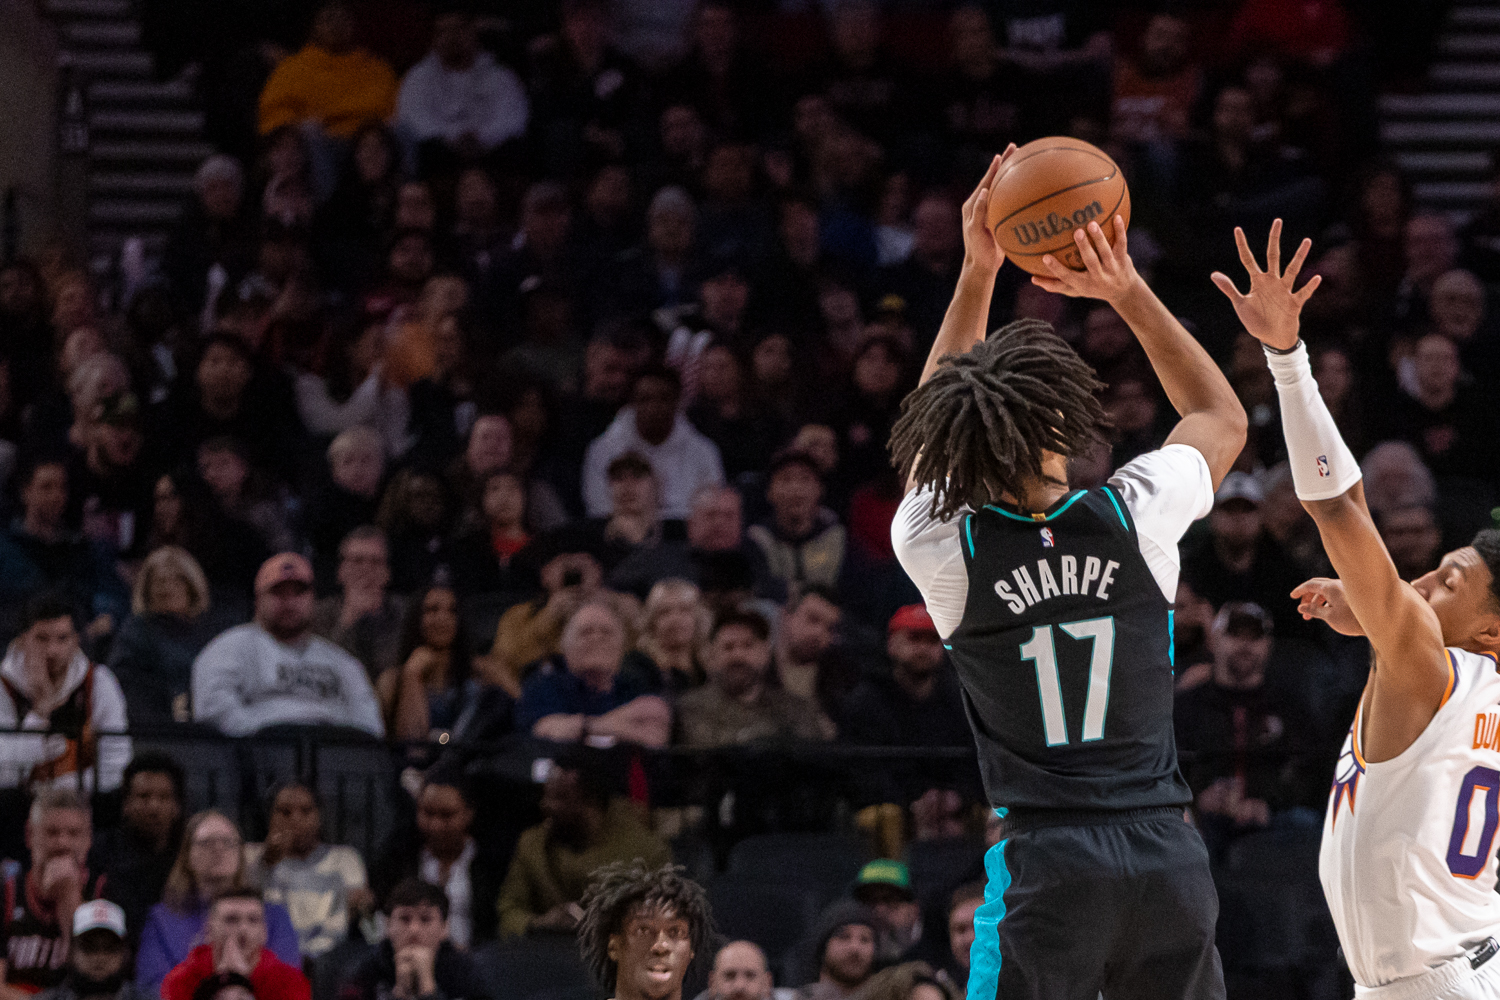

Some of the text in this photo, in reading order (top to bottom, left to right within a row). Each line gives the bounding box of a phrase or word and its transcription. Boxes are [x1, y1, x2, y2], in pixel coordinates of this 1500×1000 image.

[1012, 201, 1103, 246] Wilson
[994, 554, 1121, 615] SHARPE
[1019, 615, 1116, 747] 17
